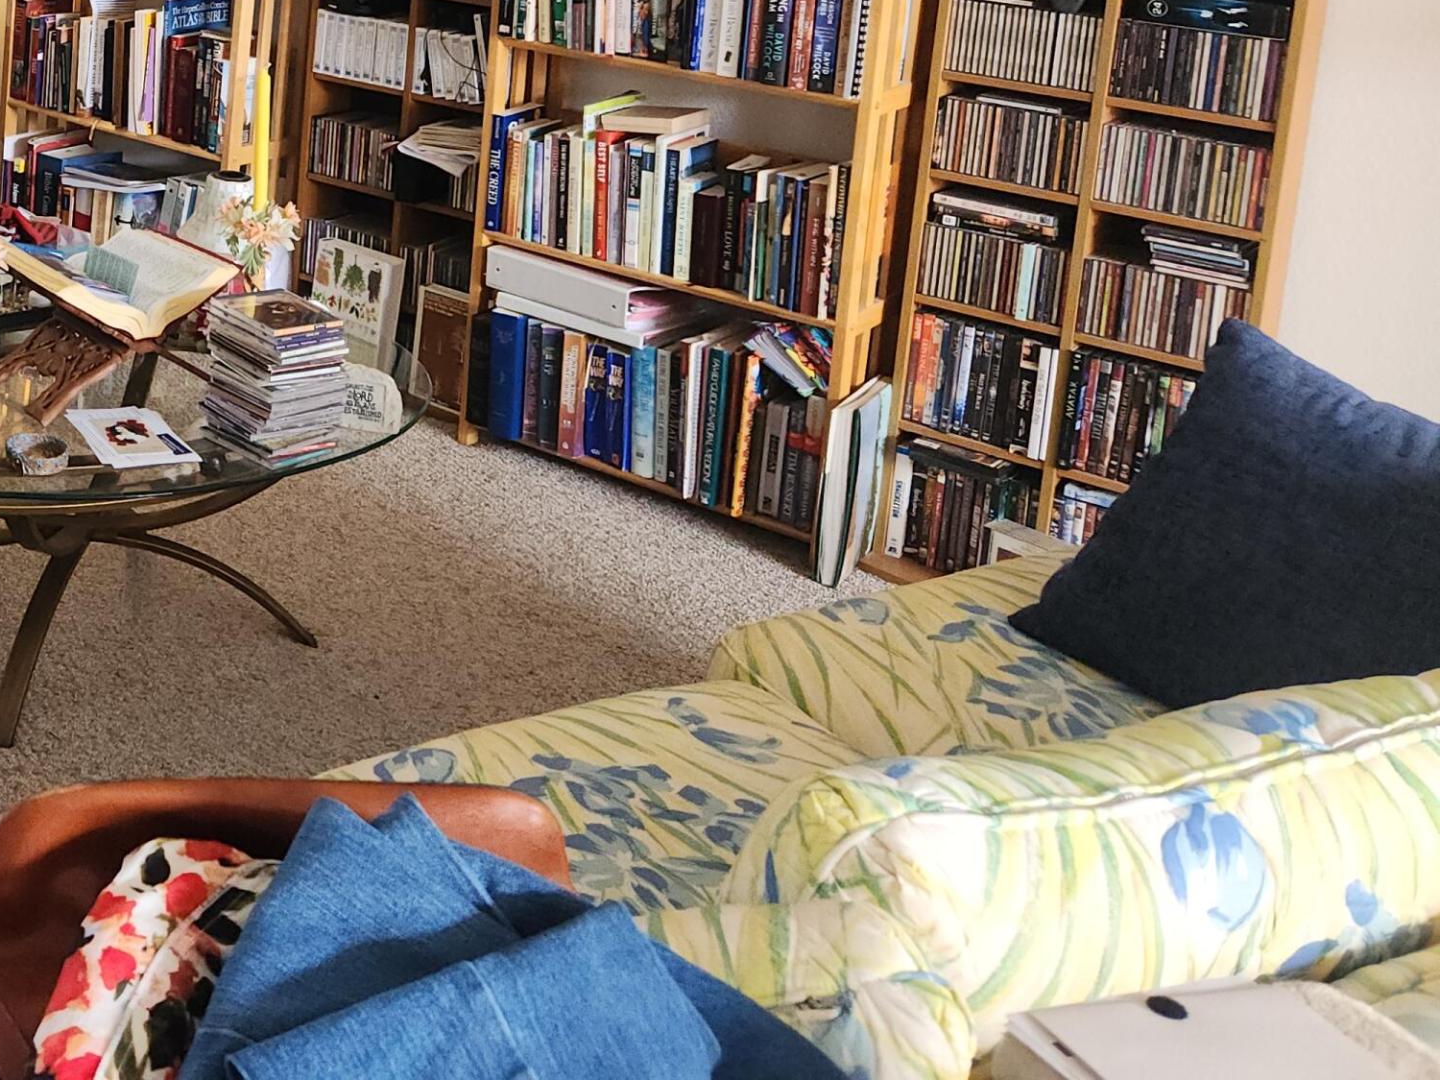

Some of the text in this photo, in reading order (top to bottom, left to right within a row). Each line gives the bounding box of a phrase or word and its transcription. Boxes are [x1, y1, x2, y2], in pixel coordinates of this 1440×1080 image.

[172, 7, 180, 15] The
[172, 10, 229, 29] ATLAS BIBLE
[763, 24, 775, 68] WILCOCK
[774, 33, 784, 61] DAVID
[813, 44, 823, 80] WILCOCK
[822, 52, 831, 74] DAVID
[597, 142, 606, 161] BEST
[487, 149, 501, 204] THE CREED
[723, 231, 733, 257] LOVE
[1065, 382, 1078, 419] AVATAR
[1096, 392, 1107, 413] TOTAL
